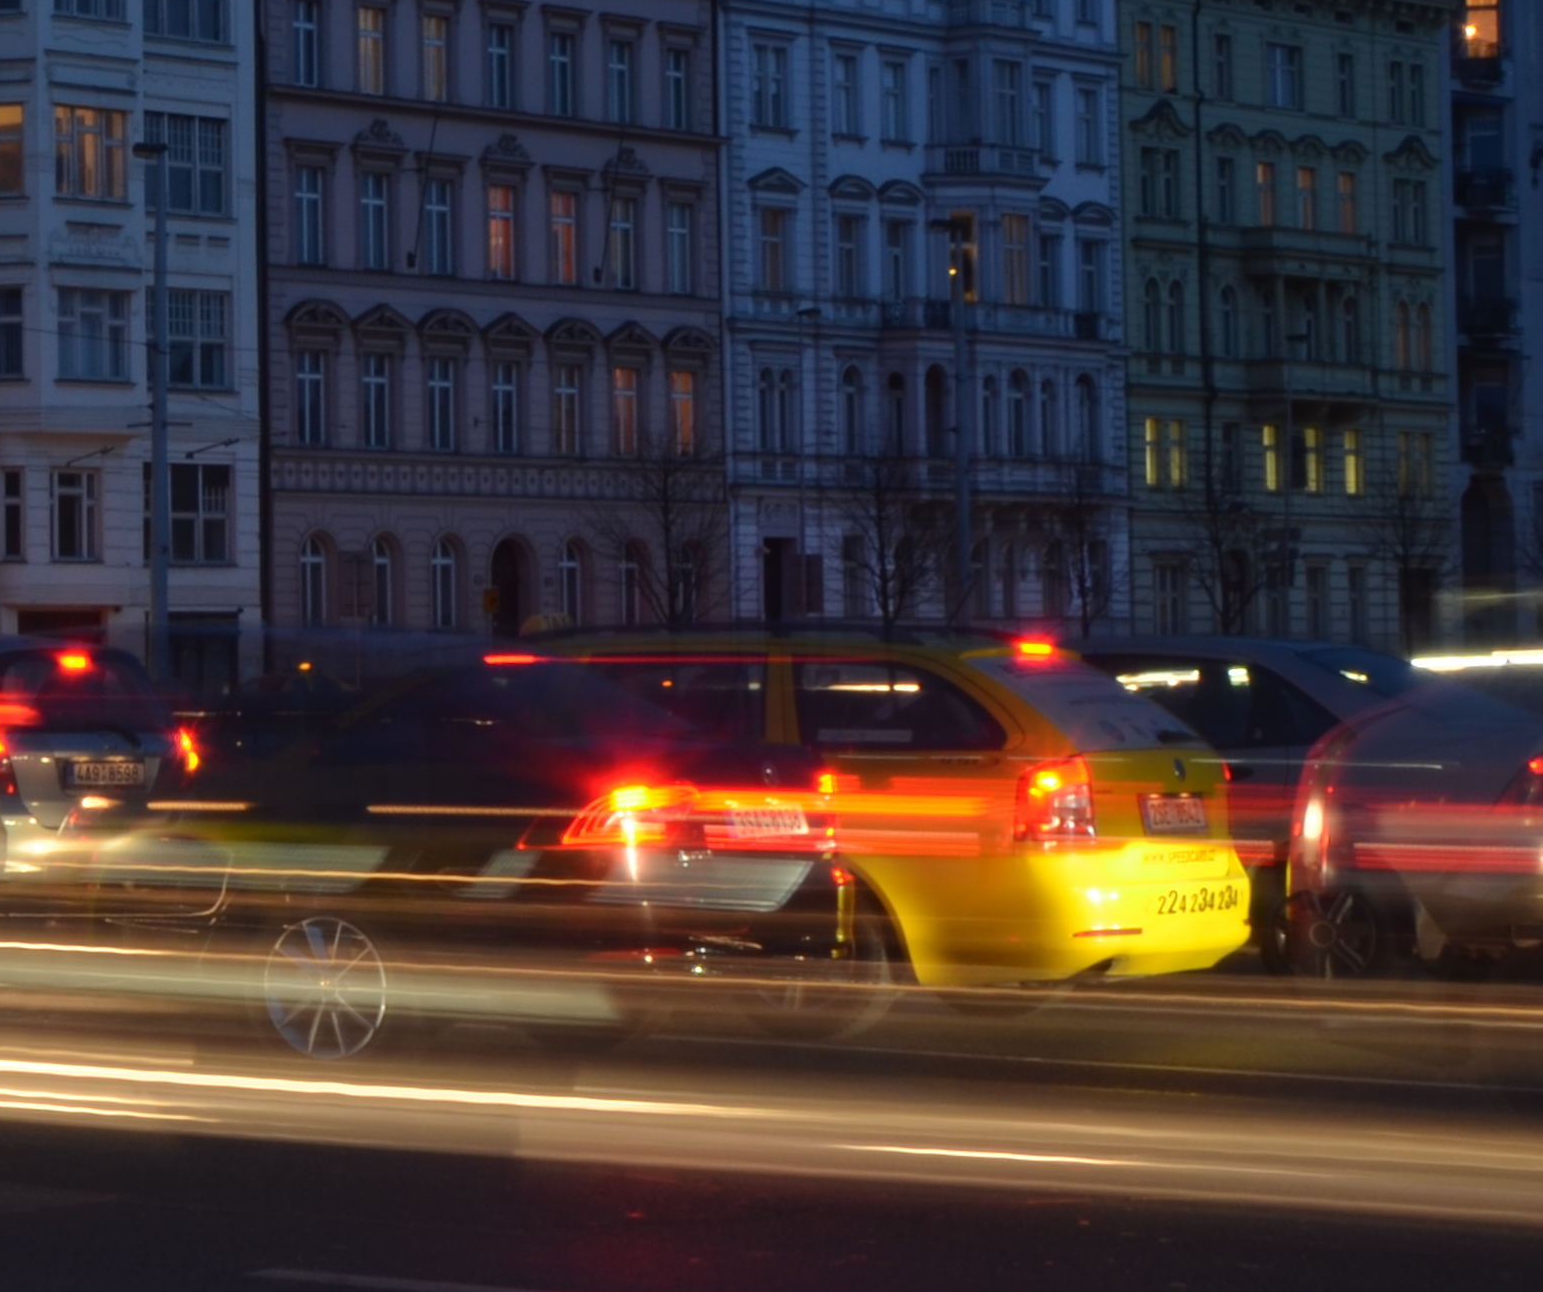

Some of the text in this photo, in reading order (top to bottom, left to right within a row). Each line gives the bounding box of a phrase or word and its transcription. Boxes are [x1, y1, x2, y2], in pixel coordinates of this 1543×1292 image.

[1157, 885, 1238, 915] 224 234 234
